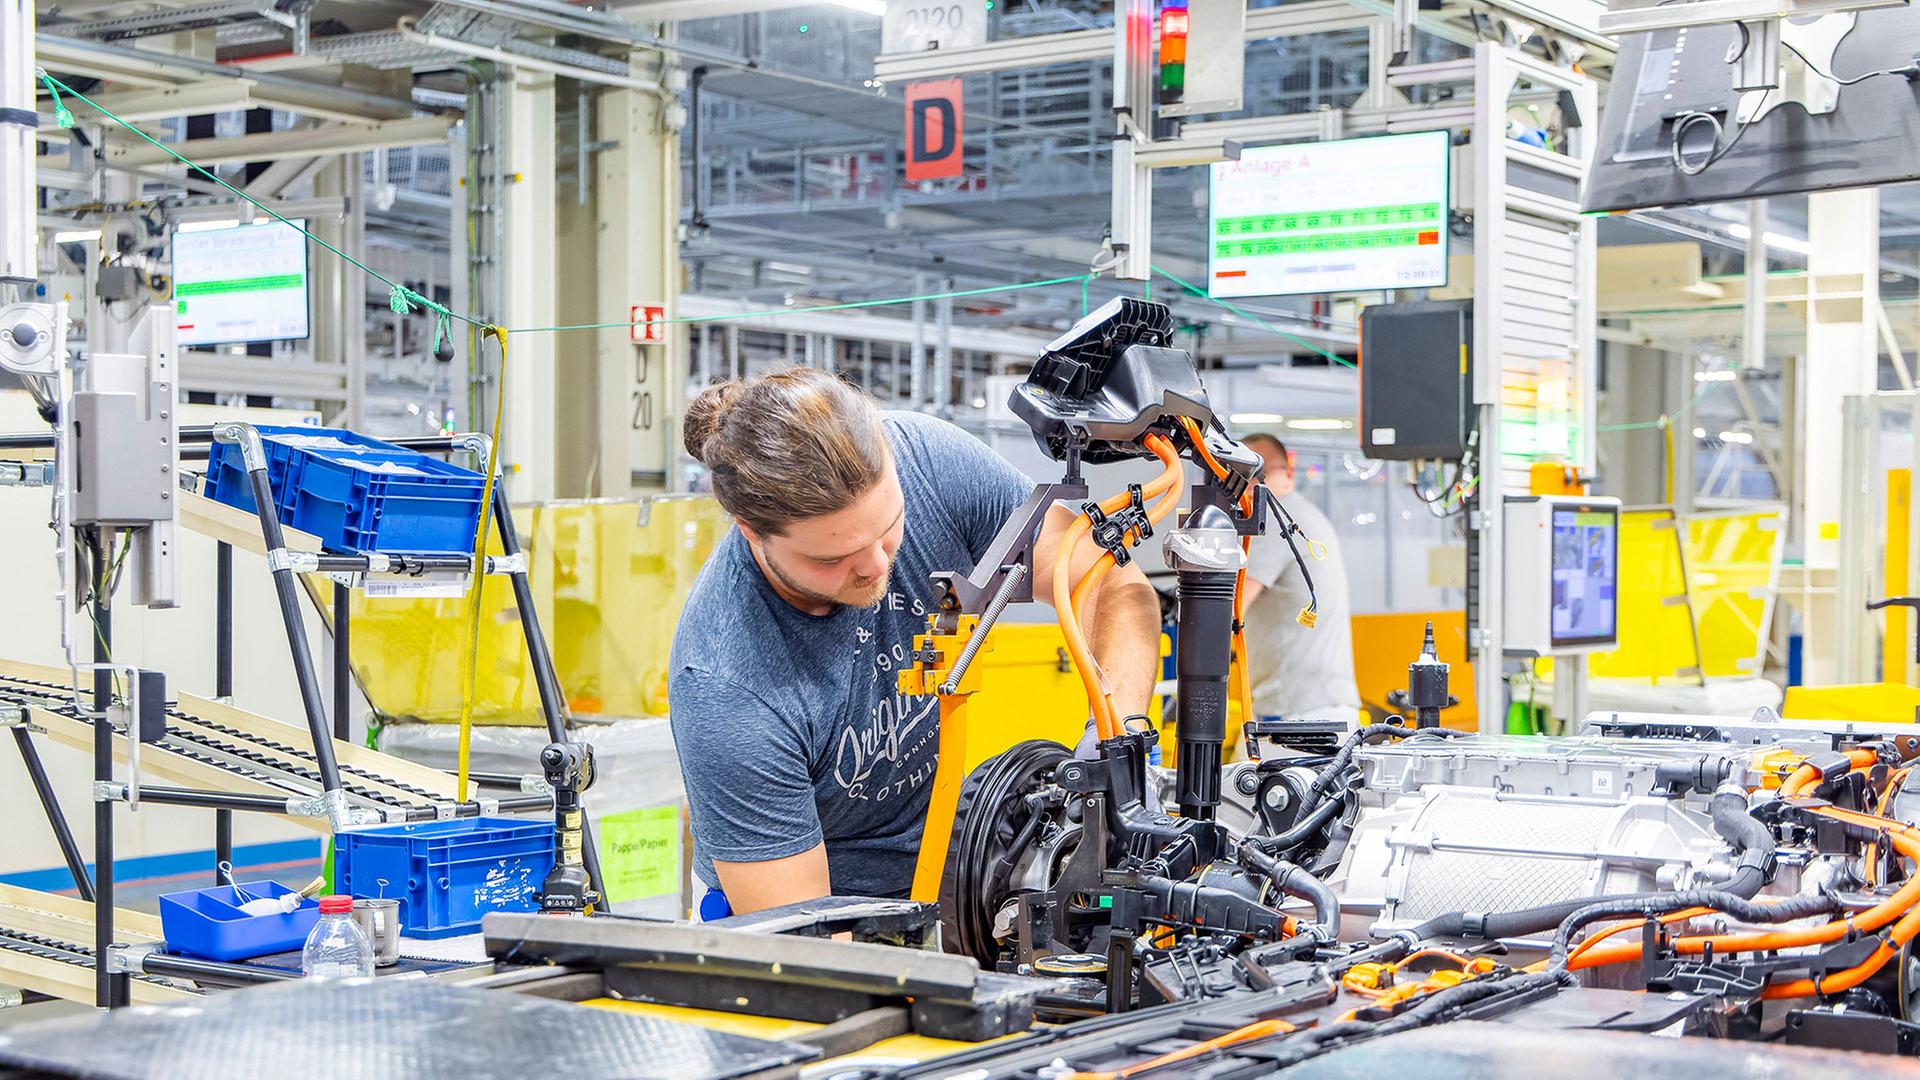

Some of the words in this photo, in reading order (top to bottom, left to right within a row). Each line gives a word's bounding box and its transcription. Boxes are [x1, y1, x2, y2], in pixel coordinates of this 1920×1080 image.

[912, 97, 957, 163] D
[632, 391, 653, 430] 20
[856, 626, 872, 644] &
[611, 837, 669, 855] Pappe/Papier
